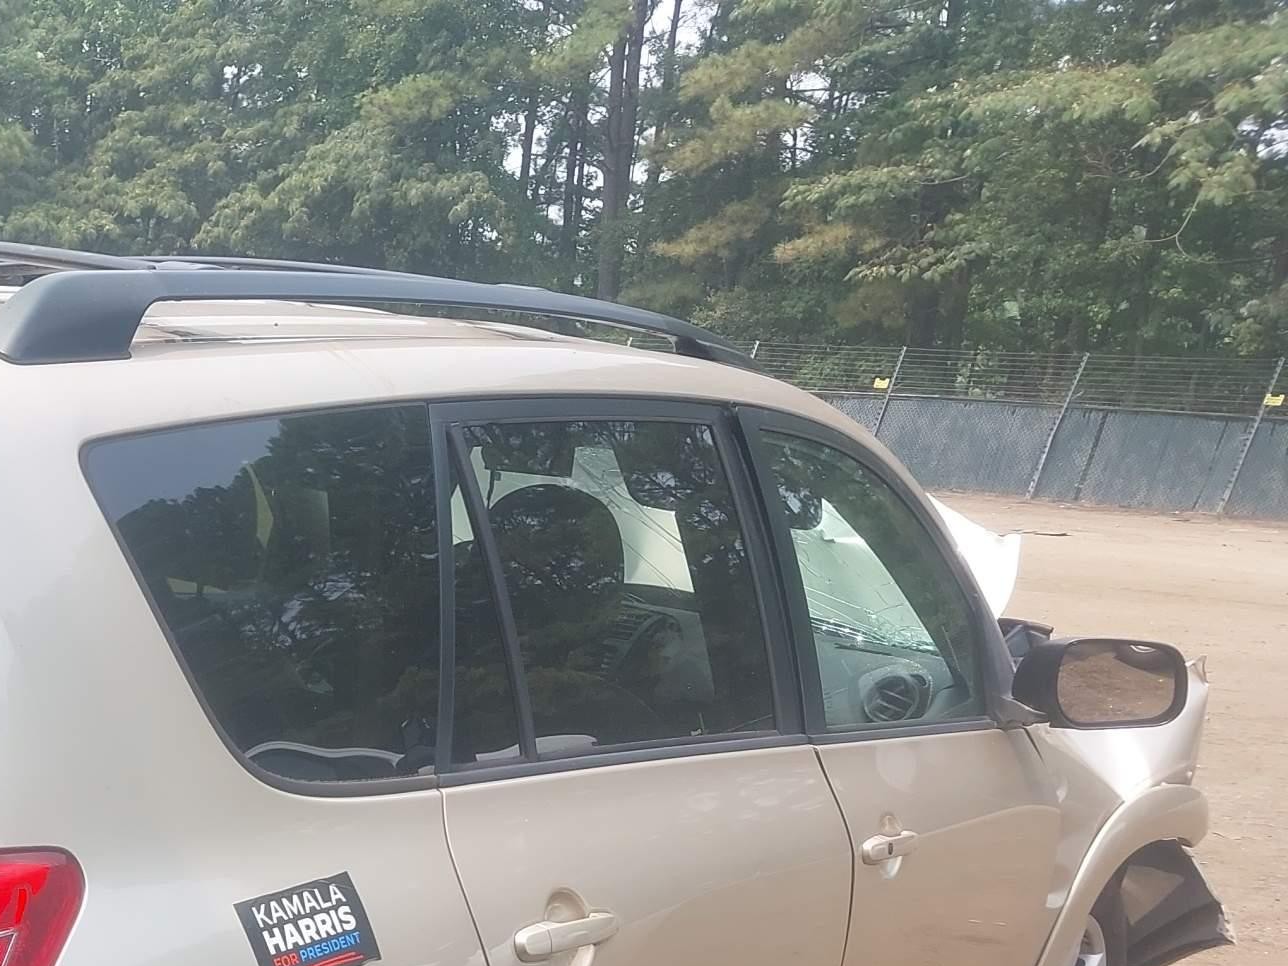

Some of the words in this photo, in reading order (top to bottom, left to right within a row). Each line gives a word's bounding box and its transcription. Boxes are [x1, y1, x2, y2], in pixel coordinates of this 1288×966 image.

[251, 883, 347, 929] KAMALA
[262, 905, 357, 956] HARRIS
[299, 931, 361, 963] PRESIDENT
